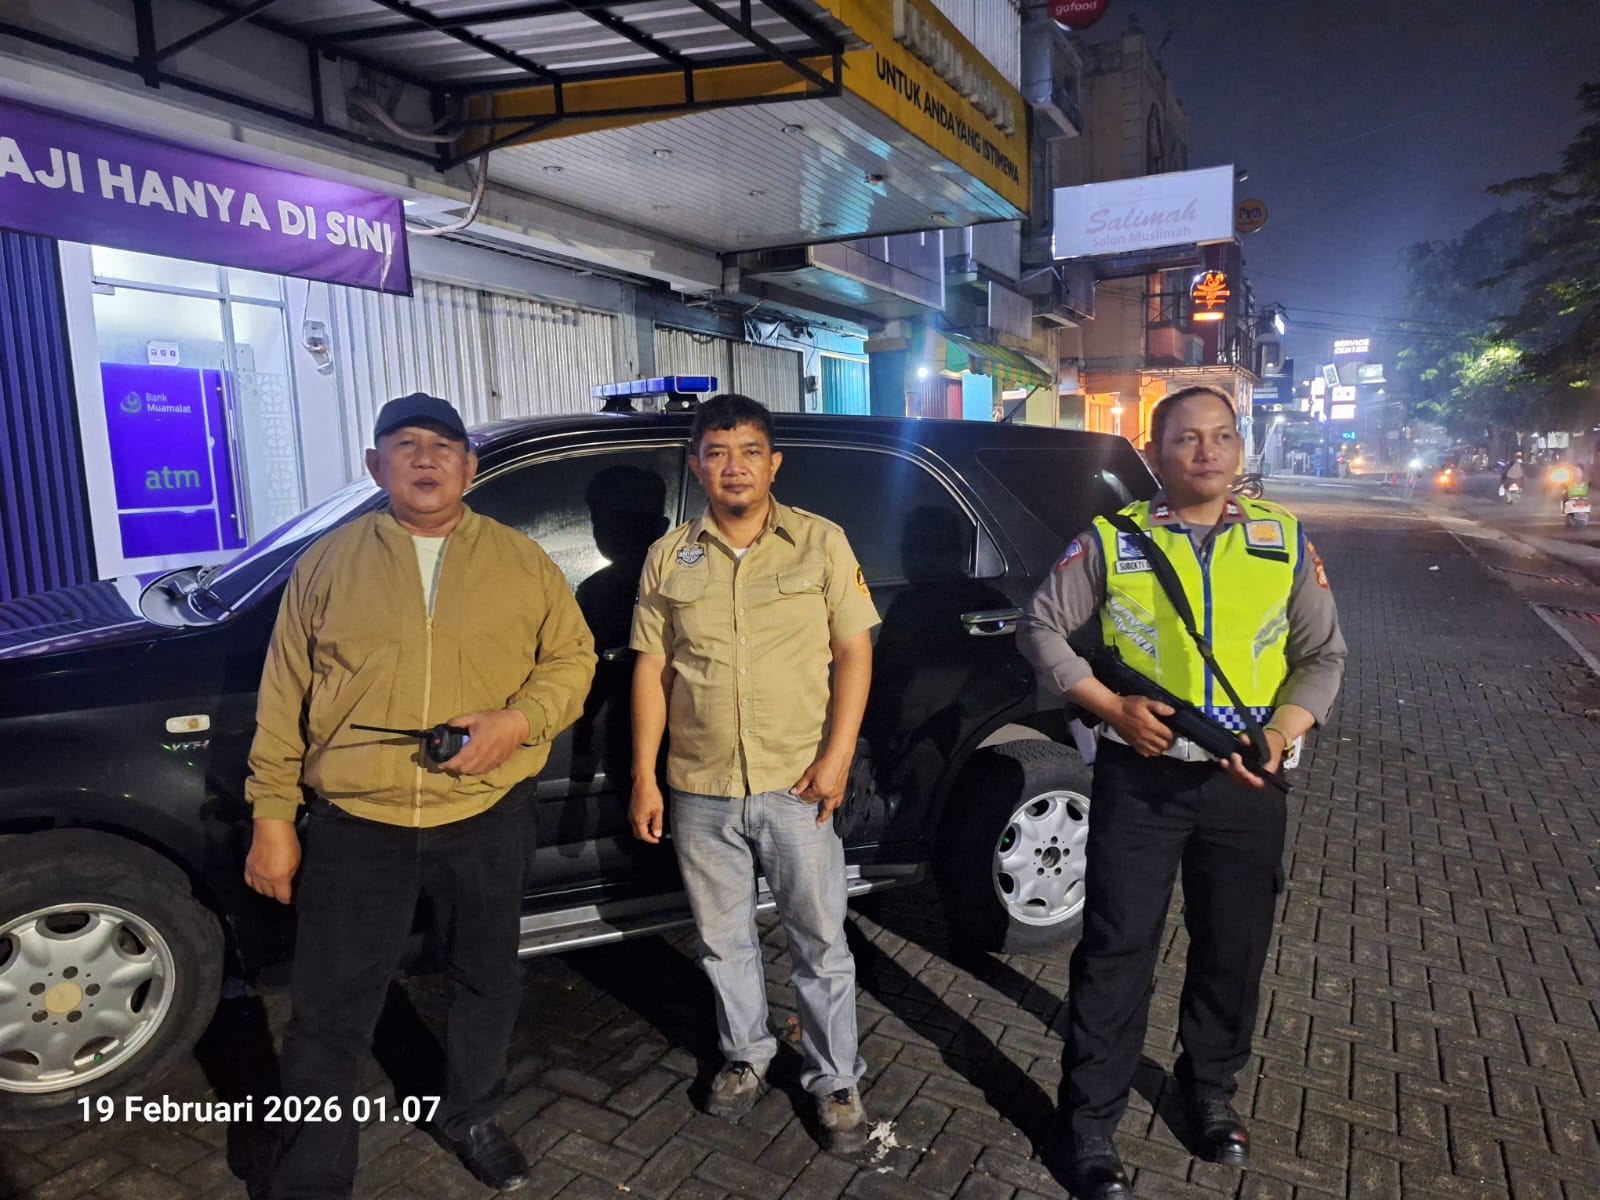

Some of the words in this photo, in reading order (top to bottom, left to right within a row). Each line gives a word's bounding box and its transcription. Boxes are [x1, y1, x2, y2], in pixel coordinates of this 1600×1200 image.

[1056, 1, 1097, 16] gofood
[875, 52, 921, 110] UNTUK
[923, 91, 955, 136] ANDA
[954, 113, 981, 153] YANG
[982, 137, 1020, 186] ISTIMEWA
[97, 158, 271, 232] HANYA
[277, 199, 317, 240] DI
[326, 211, 394, 256] SINI
[1086, 197, 1199, 234] Salimah
[1092, 233, 1126, 248] Salon
[1129, 226, 1191, 243] Muslimah
[145, 392, 168, 402] Bank
[146, 404, 192, 414] Muamalat
[145, 466, 200, 489] atm
